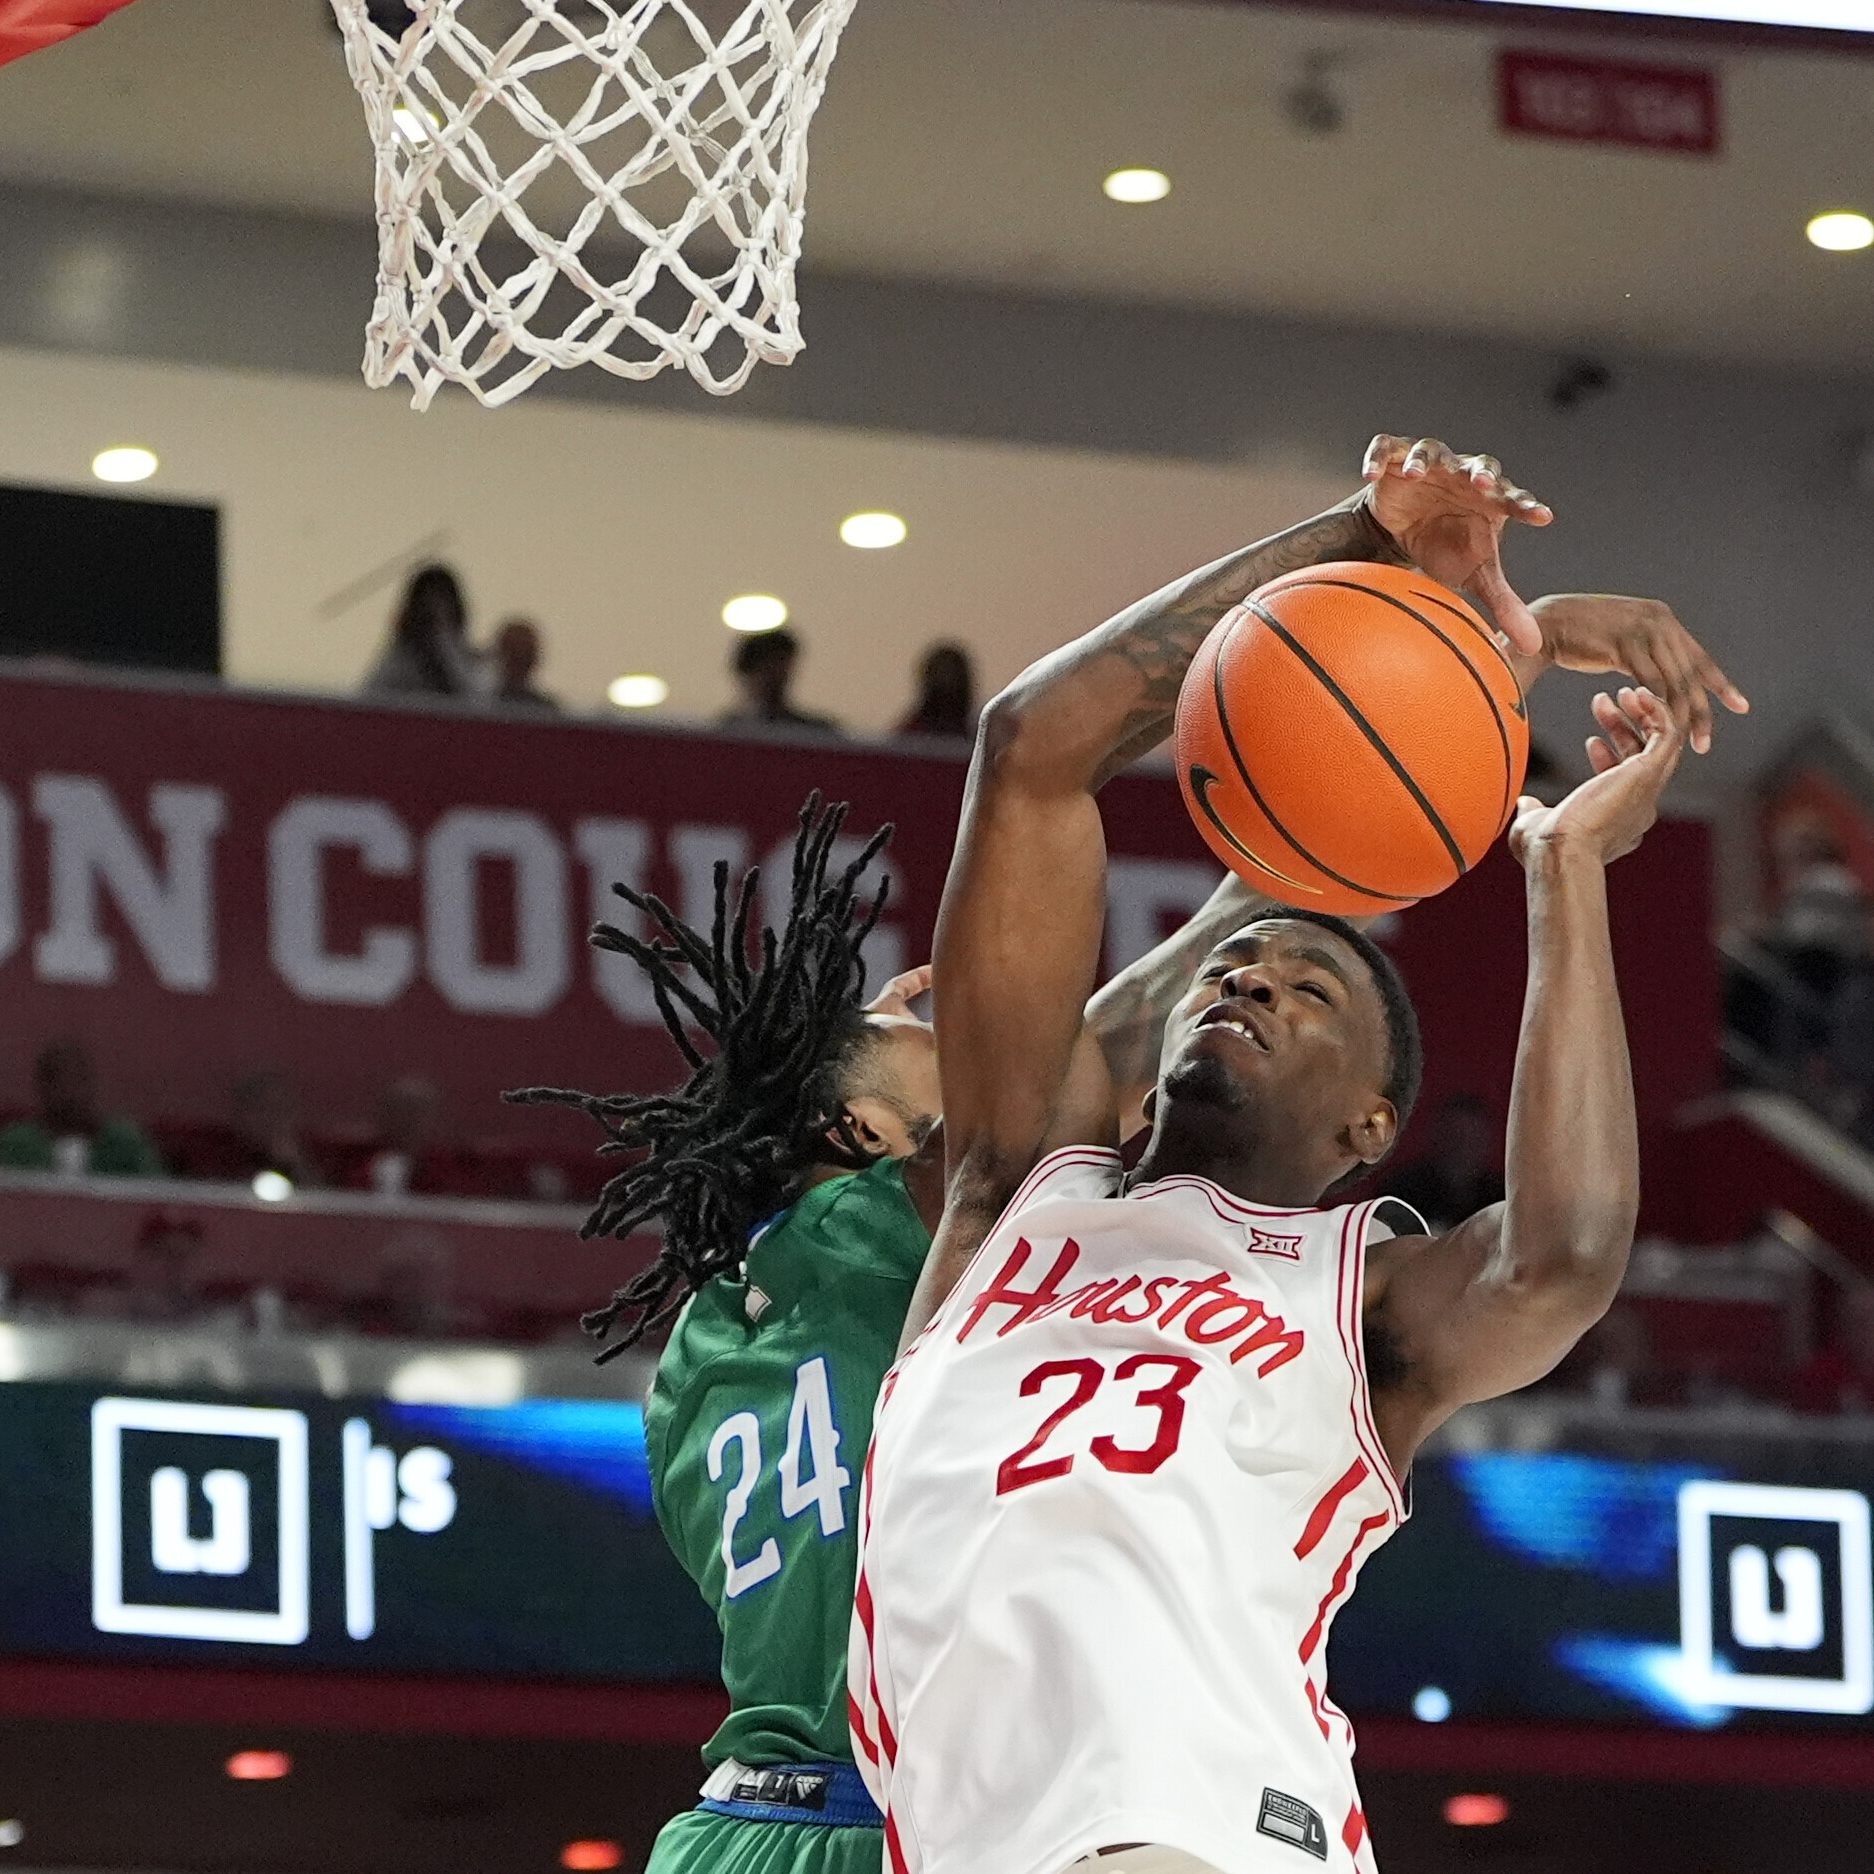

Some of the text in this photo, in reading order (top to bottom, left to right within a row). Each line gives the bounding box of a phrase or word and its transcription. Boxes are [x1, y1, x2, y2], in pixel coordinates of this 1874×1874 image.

[955, 1236, 1305, 1380] Houston
[705, 1356, 851, 1600] 24
[995, 1354, 1203, 1497] 23
